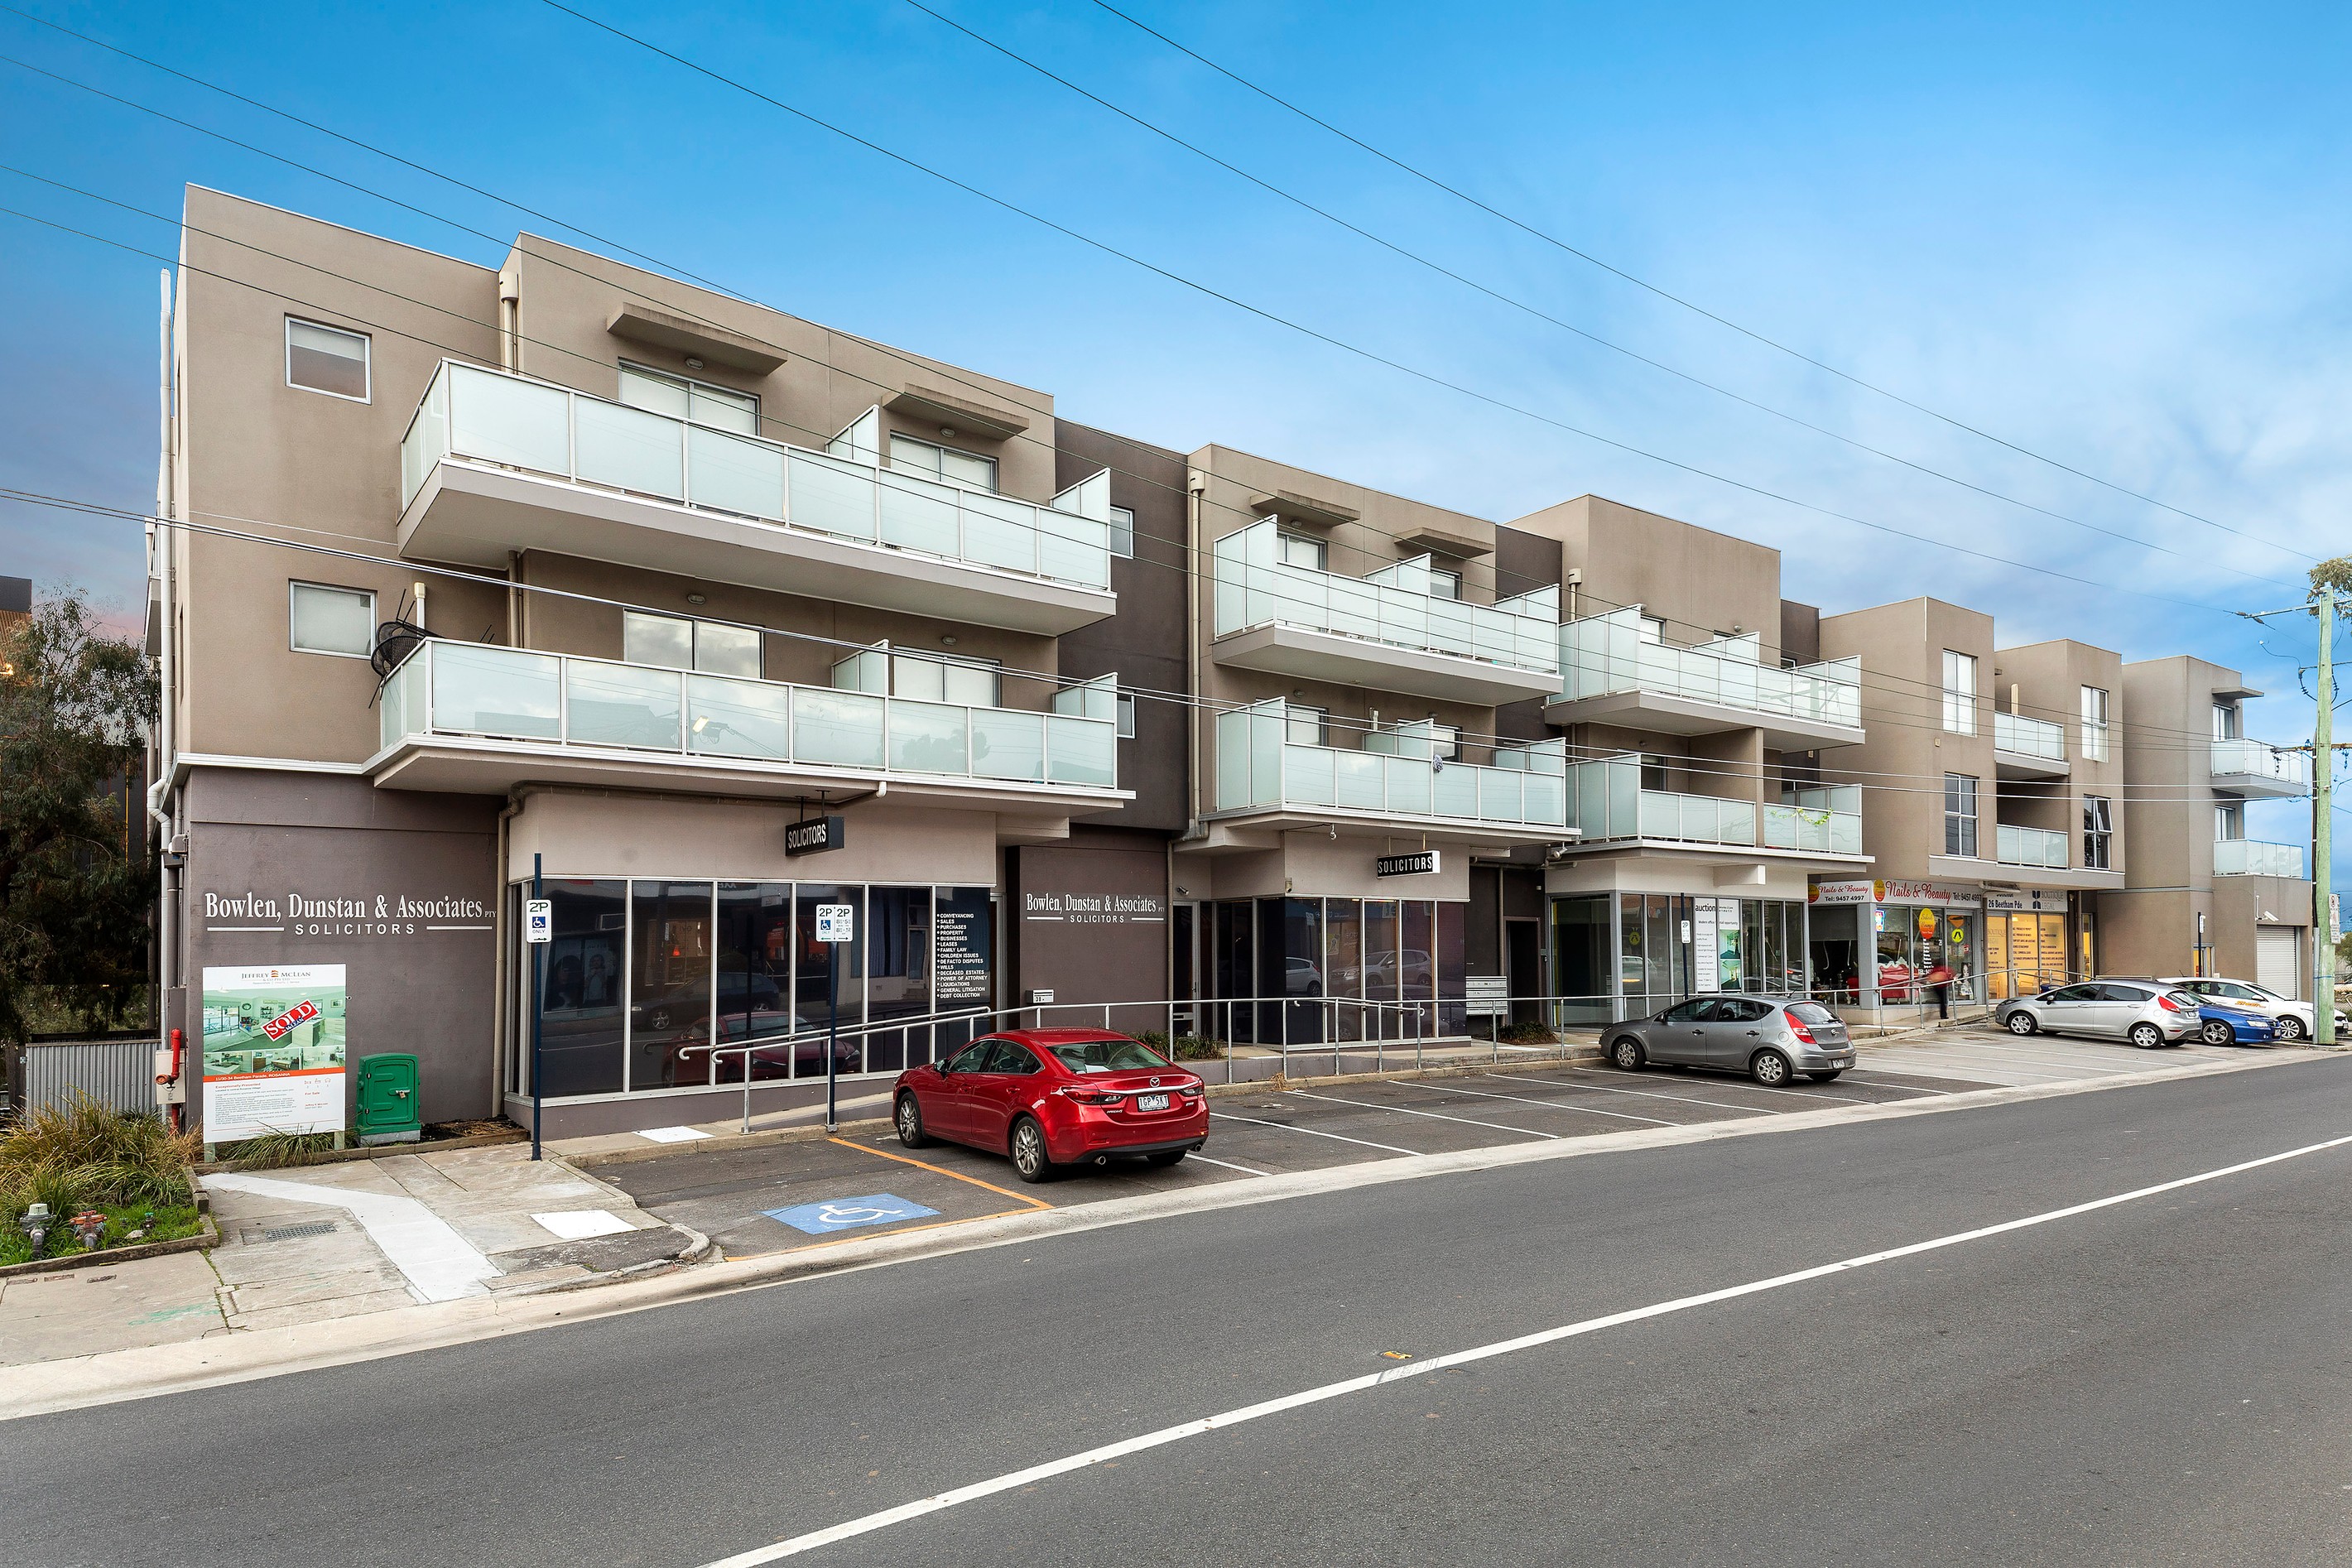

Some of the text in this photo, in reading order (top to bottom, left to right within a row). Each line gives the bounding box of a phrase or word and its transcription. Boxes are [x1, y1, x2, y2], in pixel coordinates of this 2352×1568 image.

[788, 824, 826, 849] SOLICITORS
[1378, 856, 1432, 873] SOLICITORS
[1845, 884, 1869, 894] Beauty
[1886, 880, 1912, 897] Nails
[1913, 884, 1921, 898] &
[1921, 883, 1951, 905] Beauty
[1952, 892, 1982, 902] Tel: 9457 4997
[2041, 890, 2064, 902] BOUTIQUE
[204, 891, 281, 923] Bowlen,
[288, 893, 366, 918] Dunstan
[374, 894, 388, 919] &
[396, 894, 483, 918] Associates
[529, 902, 548, 912] 2P
[1026, 892, 1062, 914] Bowlen,
[1065, 893, 1100, 911] Dunstan
[1104, 895, 1112, 911] &
[1113, 895, 1157, 912] Associates
[1695, 903, 1716, 911] auction
[1988, 899, 2023, 909] 26 Beetham Pde
[2042, 902, 2055, 910] LEGAL
[819, 907, 832, 916] 2P
[837, 908, 850, 917] 2P
[1070, 915, 1124, 923] SOLICITORS
[295, 923, 415, 936] SOLICITORS
[266, 1003, 312, 1036] SOLD
